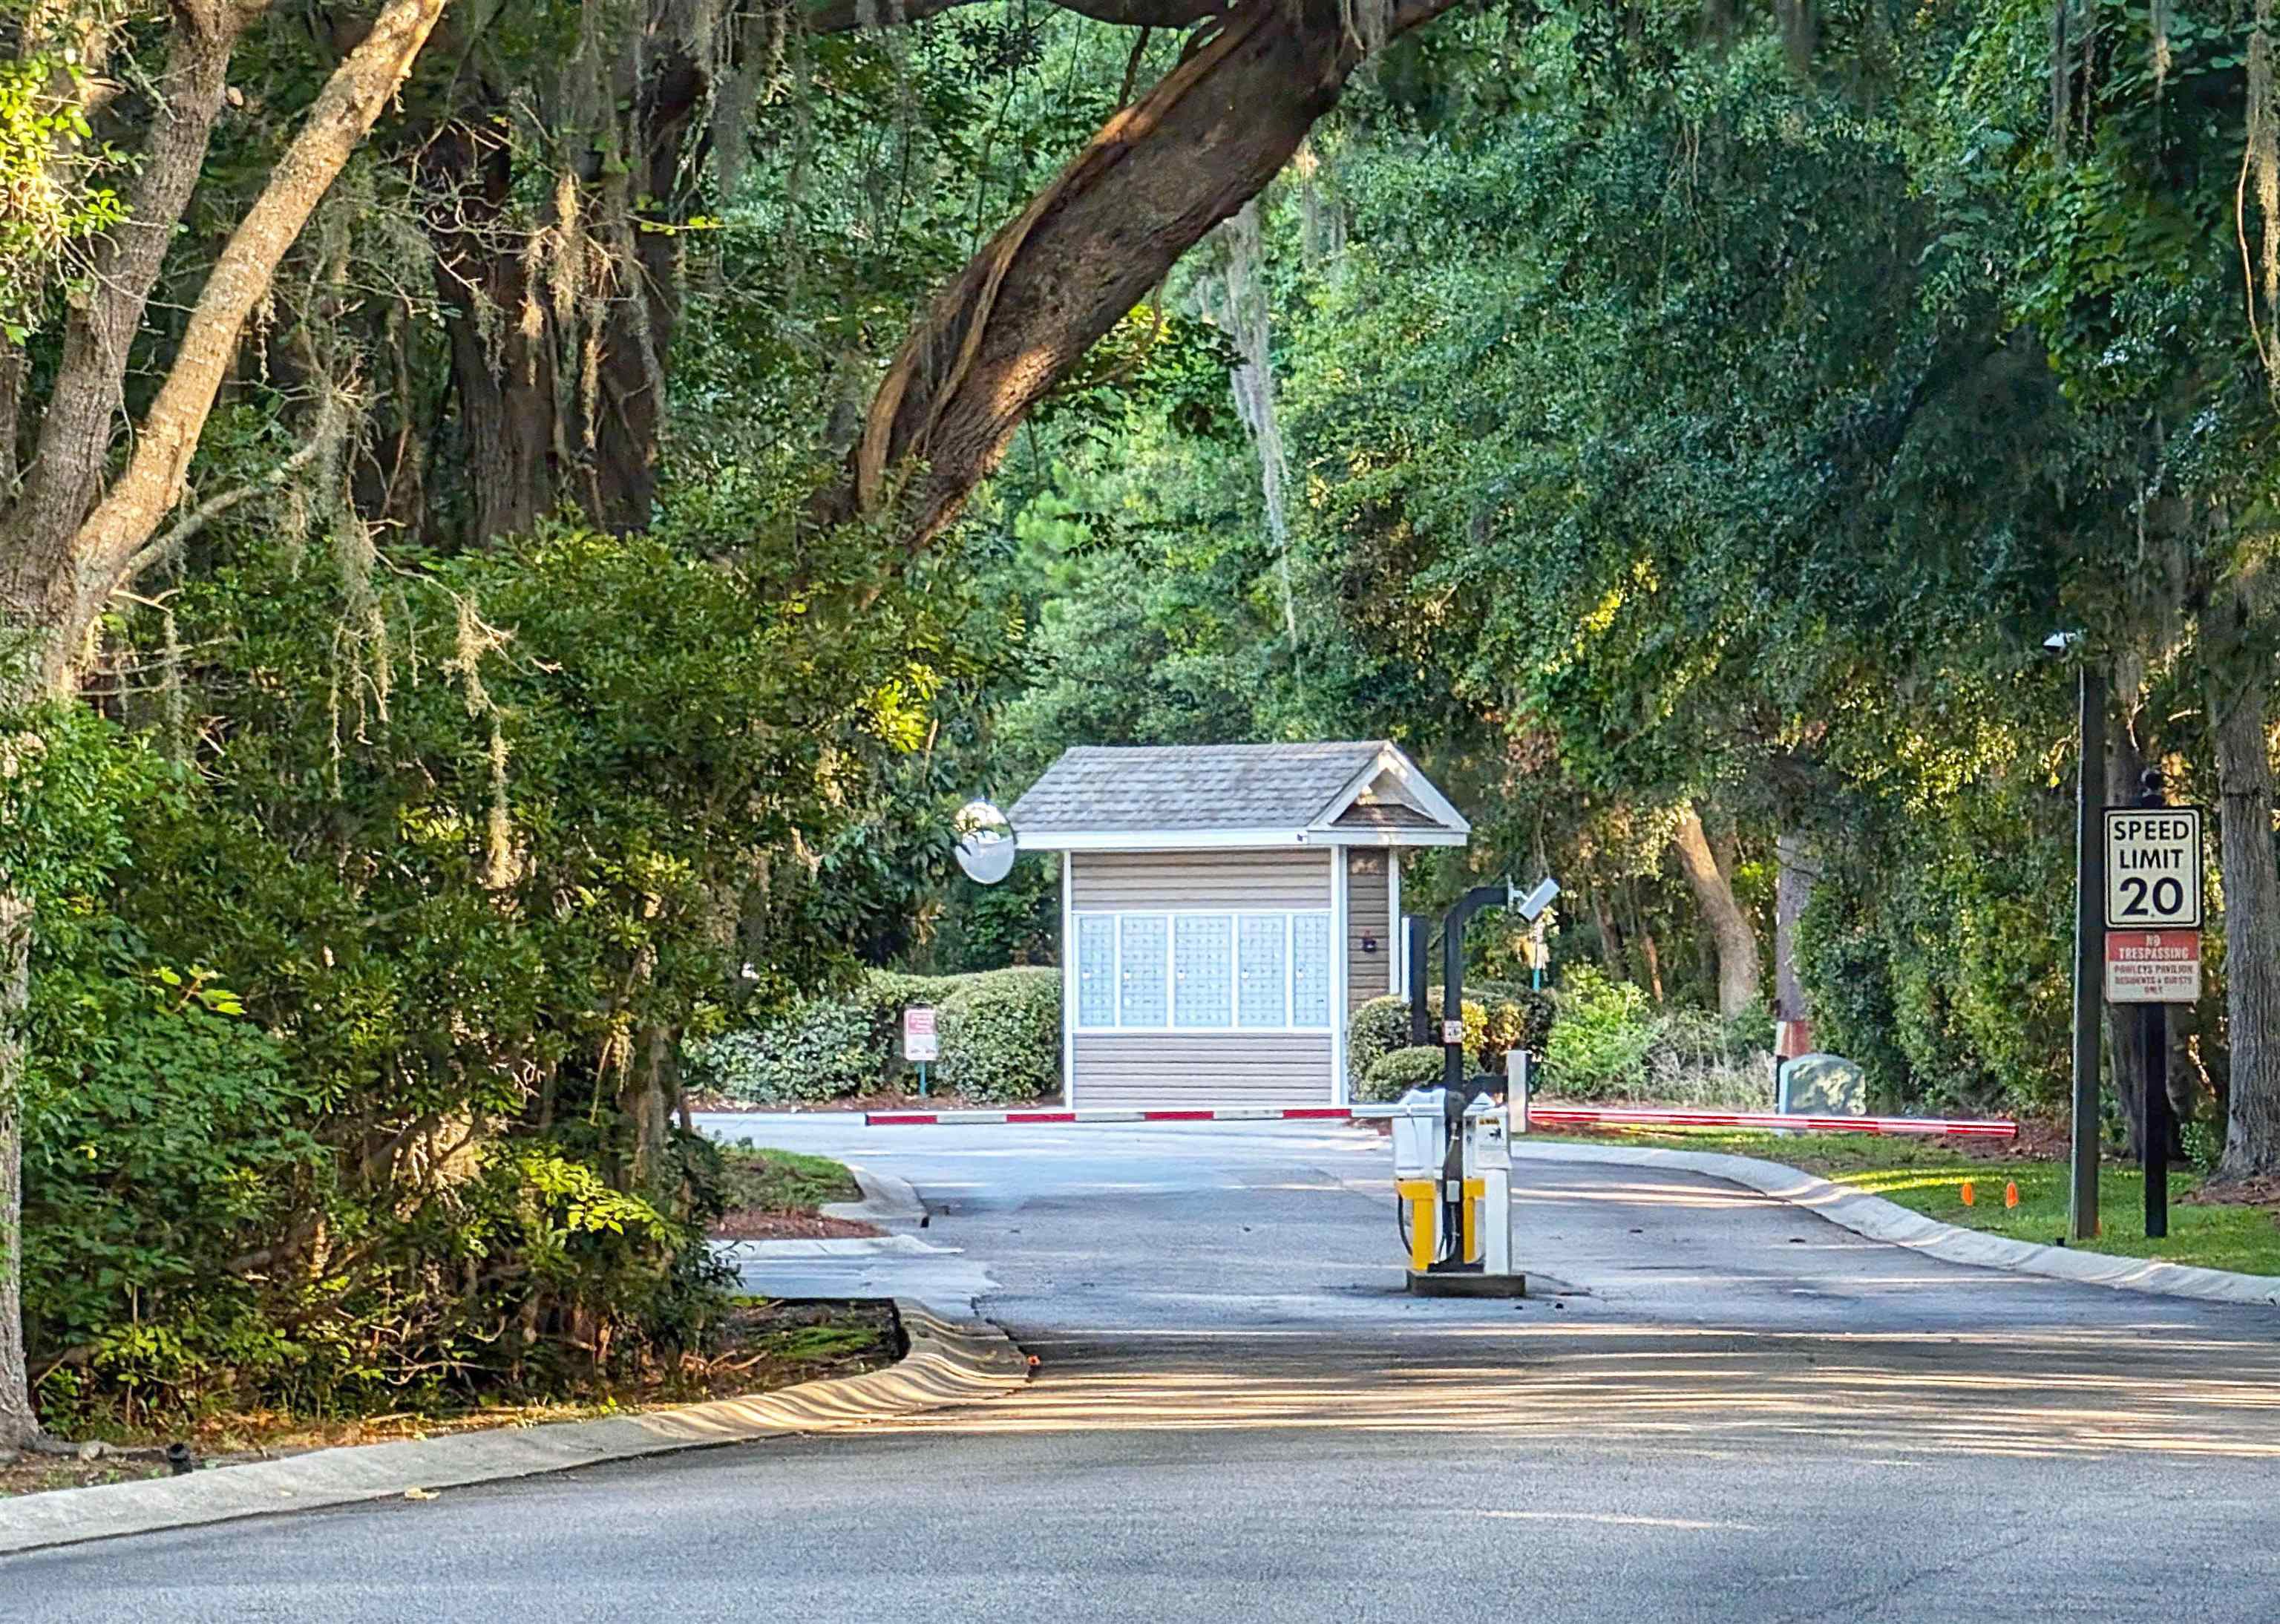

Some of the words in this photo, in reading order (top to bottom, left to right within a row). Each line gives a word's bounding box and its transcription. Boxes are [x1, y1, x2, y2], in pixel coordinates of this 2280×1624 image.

[2114, 820, 2189, 841] SPEED
[2120, 849, 2184, 869] LIMIT
[2120, 877, 2184, 916] 20
[2146, 934, 2161, 946] NO
[2119, 947, 2189, 960] TRESPASSING
